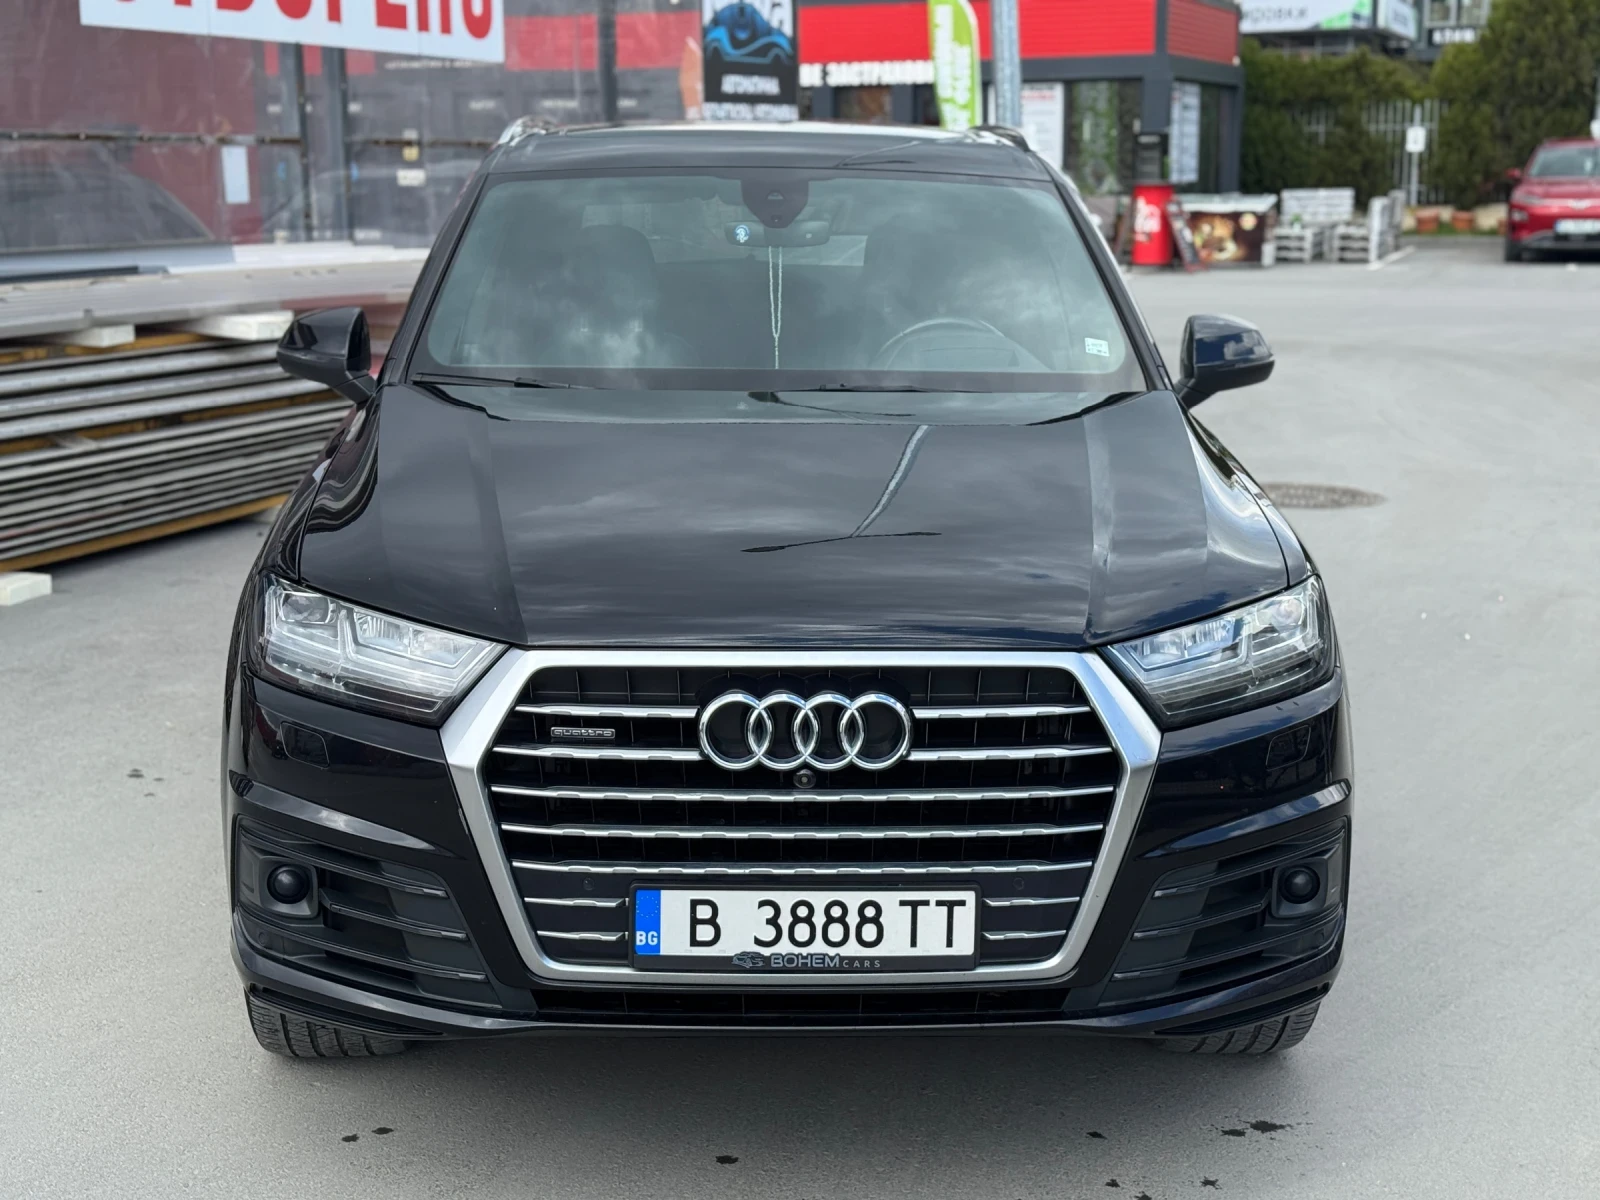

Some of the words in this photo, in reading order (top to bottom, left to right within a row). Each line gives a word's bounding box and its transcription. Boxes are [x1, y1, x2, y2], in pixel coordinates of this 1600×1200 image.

[554, 729, 612, 737] quattro
[689, 898, 722, 948] B
[753, 898, 884, 948] 3888
[899, 899, 966, 948] TT
[636, 931, 658, 946] BG
[770, 955, 840, 968] BOHEM
[843, 960, 881, 968] CARS
